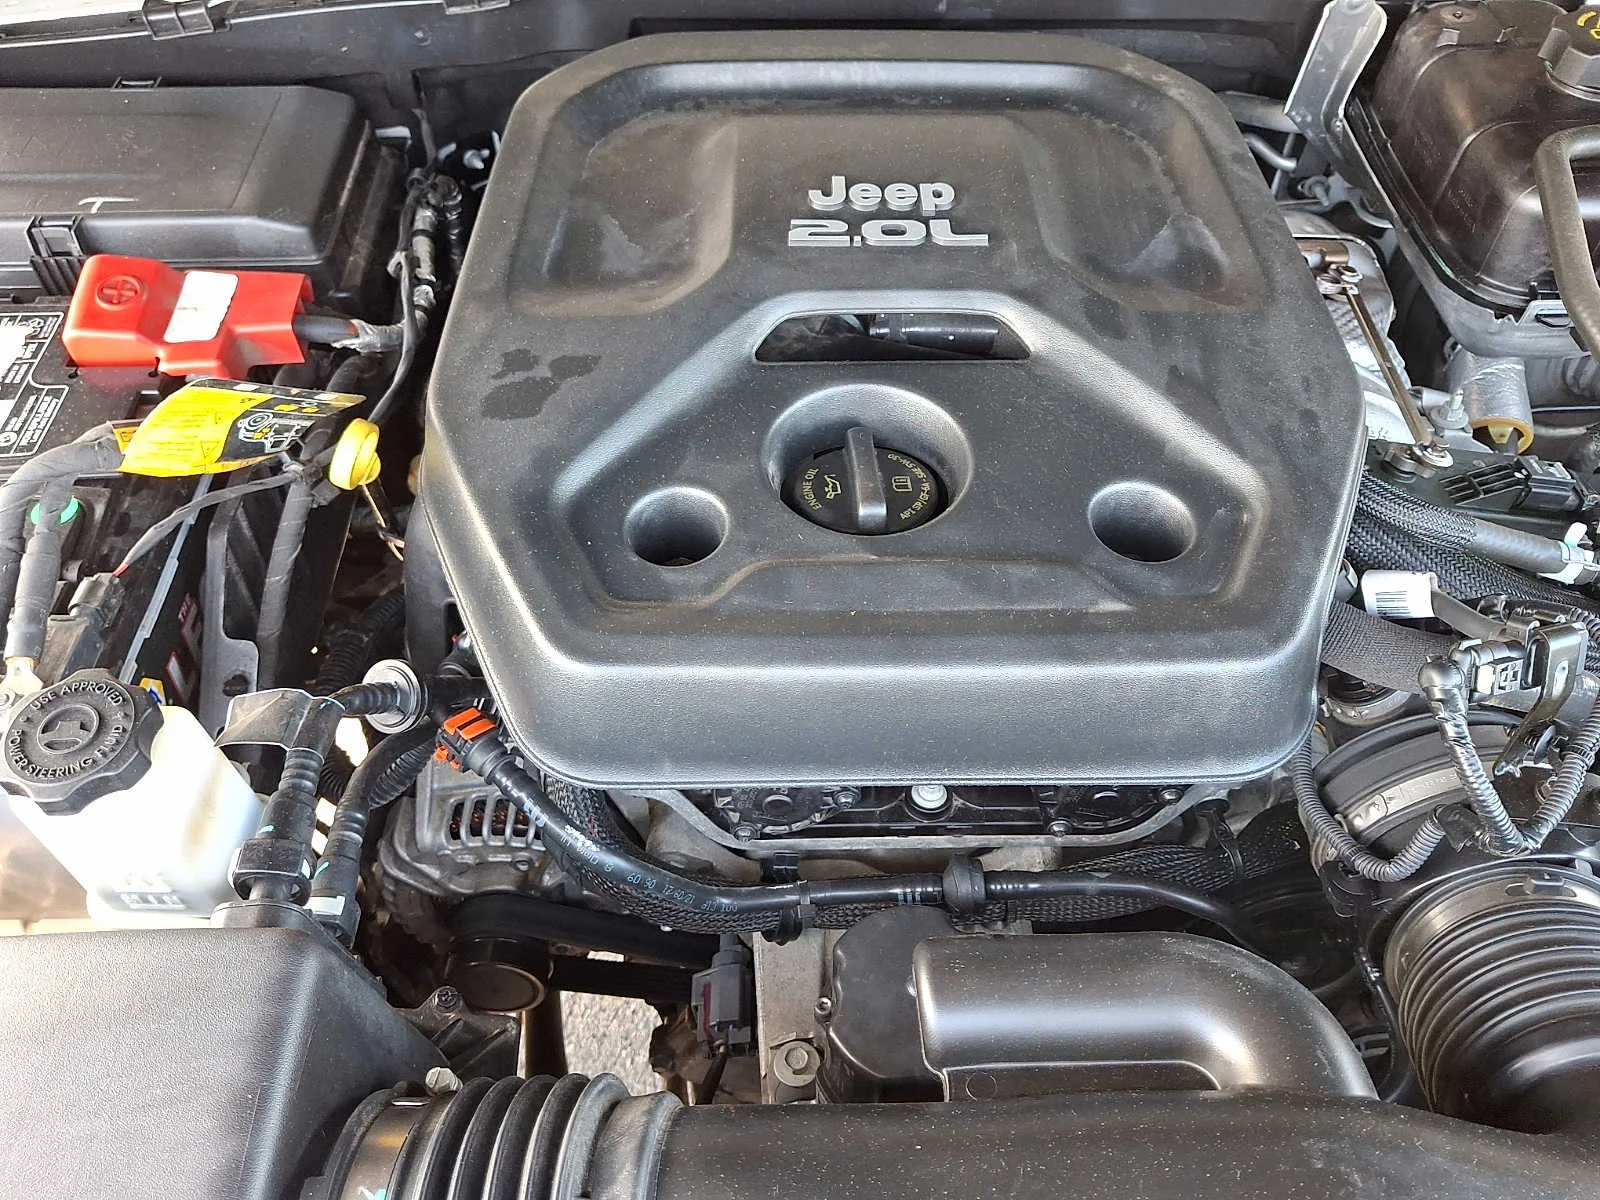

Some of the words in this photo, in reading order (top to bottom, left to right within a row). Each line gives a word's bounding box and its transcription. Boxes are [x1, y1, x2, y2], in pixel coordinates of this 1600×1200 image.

[808, 175, 955, 216] Jeep
[788, 219, 989, 247] 2.0L
[804, 468, 820, 480] OIL
[802, 480, 822, 510] ENGINE
[30, 691, 58, 711] USE
[60, 681, 126, 707] APPROVED
[8, 729, 28, 771] POWER
[26, 756, 95, 780] STEERING
[95, 724, 125, 759] FLUID
